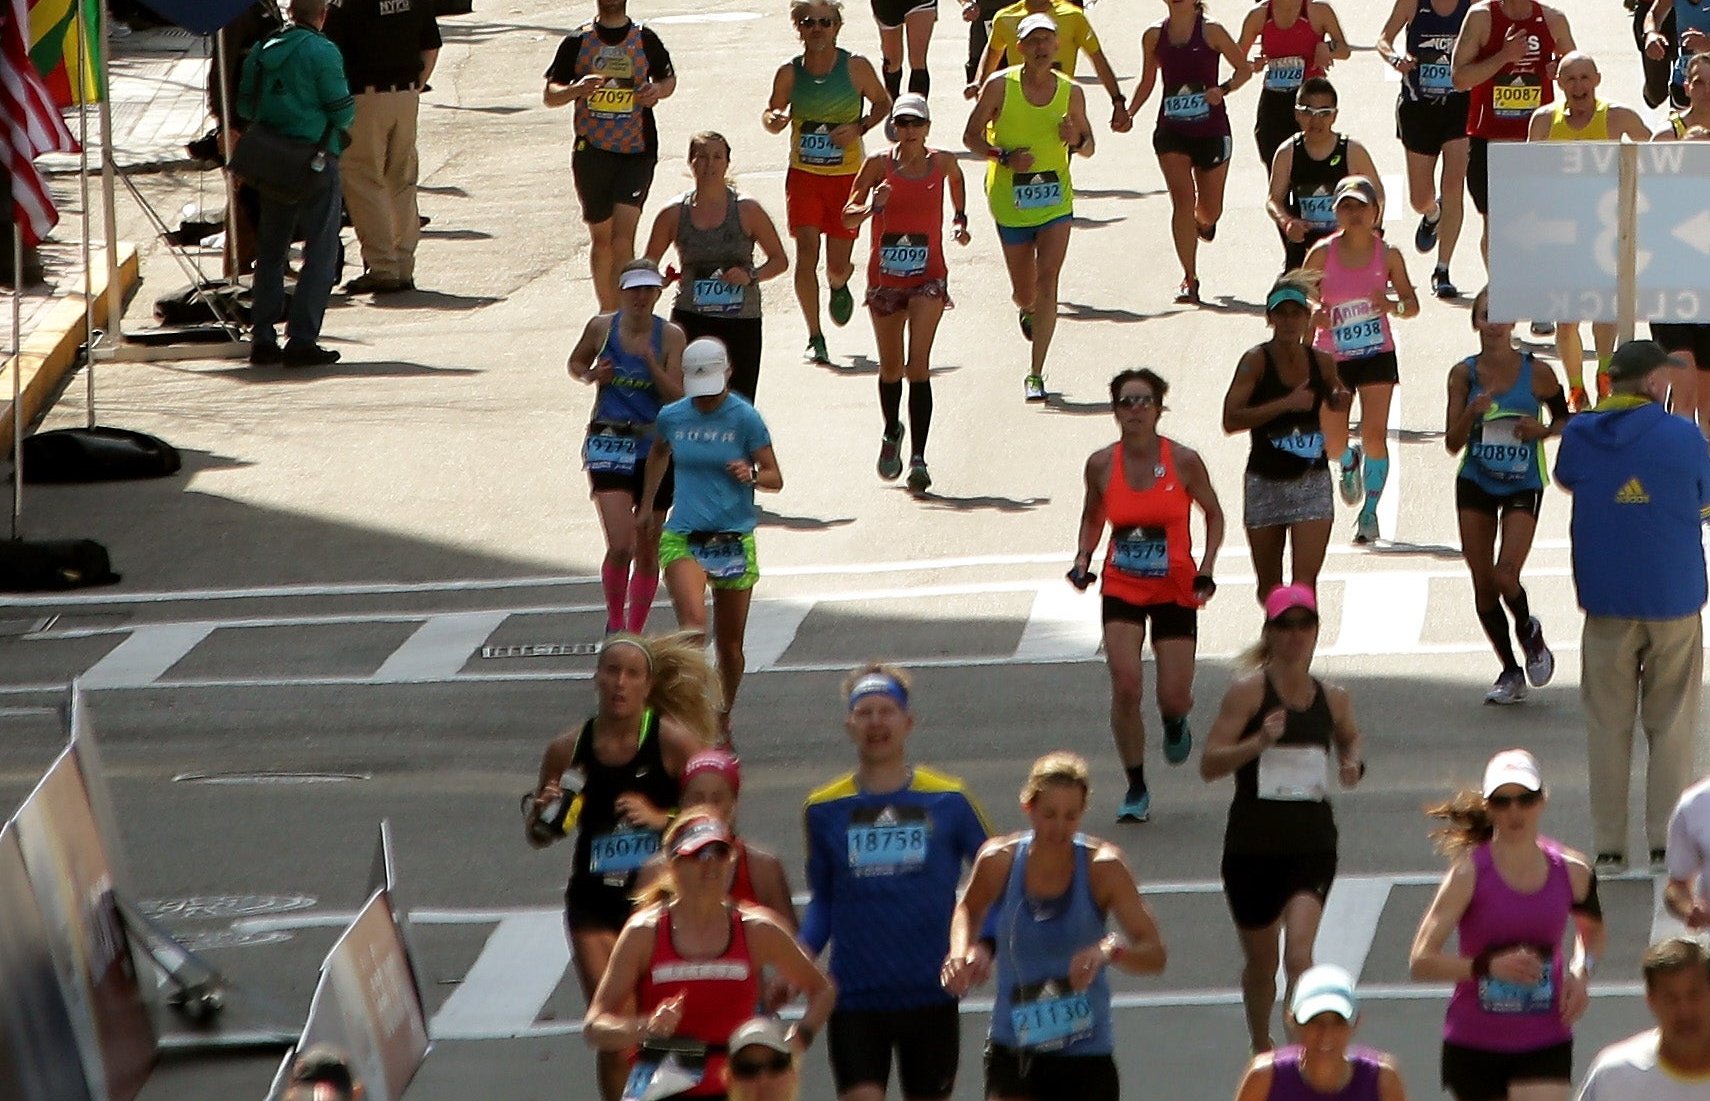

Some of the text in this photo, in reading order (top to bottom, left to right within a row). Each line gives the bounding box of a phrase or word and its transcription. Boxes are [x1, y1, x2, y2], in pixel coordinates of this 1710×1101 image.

[589, 90, 633, 104] 27097
[1495, 87, 1541, 102] 30087
[1016, 185, 1060, 200] 19532
[1301, 198, 1334, 213] 1642
[1335, 320, 1381, 342] 18938
[1474, 445, 1530, 462] 20899
[592, 835, 657, 860] 16070
[853, 830, 924, 851] 18758
[1015, 1000, 1090, 1028] 21130
